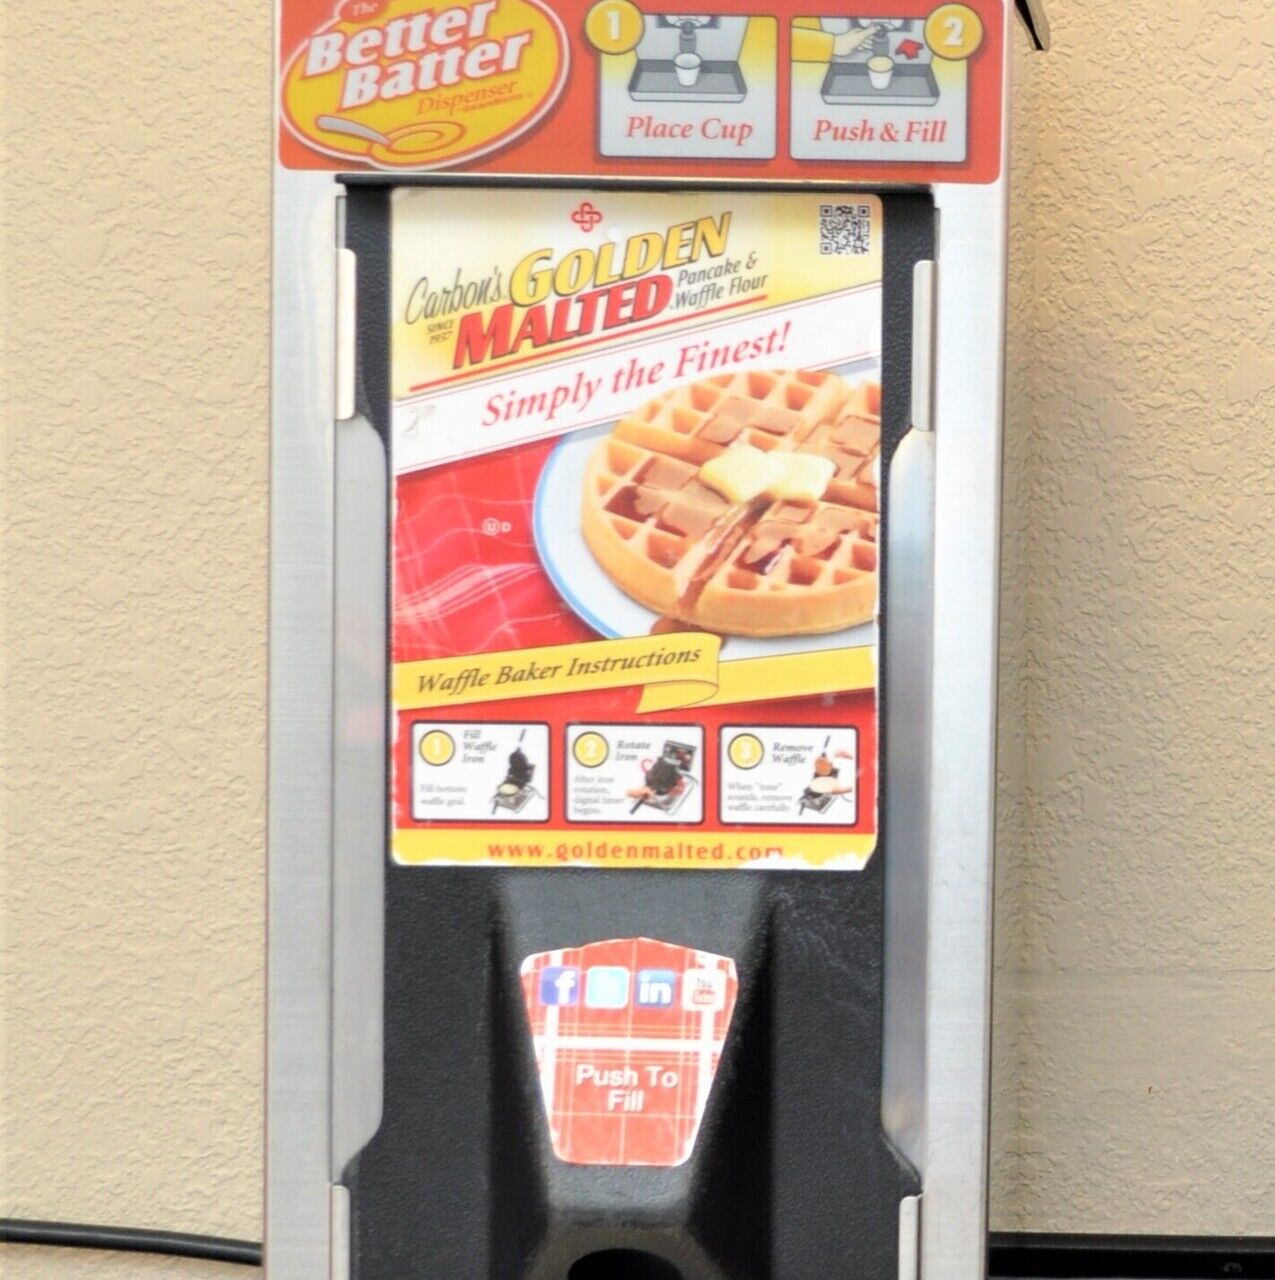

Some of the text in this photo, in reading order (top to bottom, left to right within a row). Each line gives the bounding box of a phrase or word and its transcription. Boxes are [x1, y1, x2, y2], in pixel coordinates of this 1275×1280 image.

[351, 0, 378, 17] The
[303, 0, 498, 78] Better
[606, 11, 620, 40] 1
[943, 16, 964, 46] 2
[340, 31, 533, 110] Batter
[417, 80, 518, 115] Dispenser
[626, 116, 753, 145] Place Cup
[813, 119, 947, 143] Push & Fill
[509, 211, 733, 308] GOLDEN
[677, 260, 743, 289] Pancake
[404, 266, 504, 325] Carbon's
[674, 272, 768, 310] Waffle Flour
[452, 274, 675, 371] MALTED
[481, 321, 793, 427] Simply the Finest!
[417, 646, 702, 696] Waffle Baker Instructions
[463, 741, 498, 754] Waffle
[464, 729, 481, 739] Fill
[617, 740, 651, 750] Rotate
[773, 742, 814, 752] Remove
[462, 754, 485, 764] Iron
[616, 752, 638, 761] Iron
[773, 754, 806, 766] Waffle
[487, 841, 785, 861] www.goldenmalted.com
[575, 1063, 680, 1088] Push To
[606, 1089, 645, 1112] Fill
